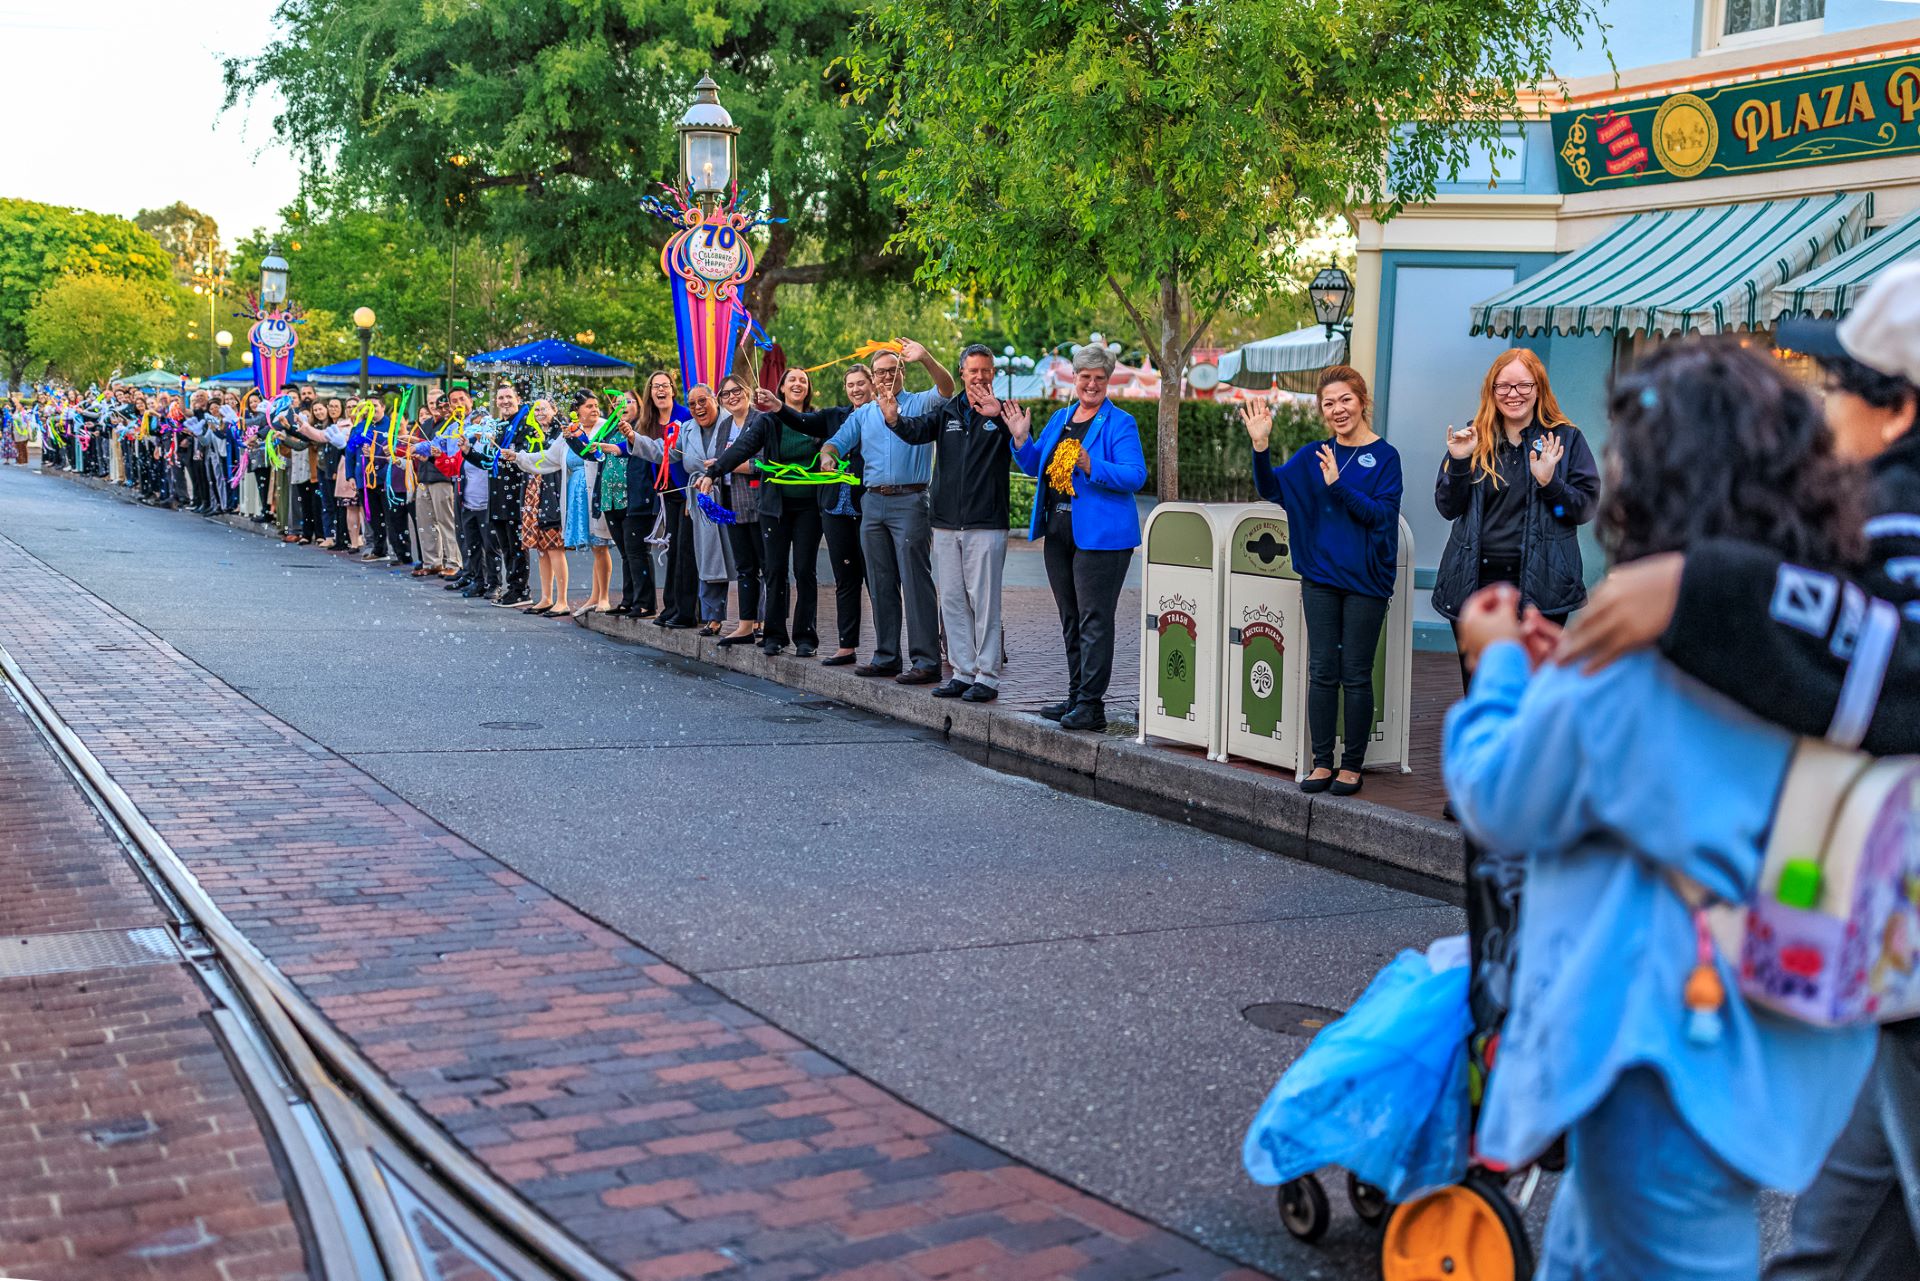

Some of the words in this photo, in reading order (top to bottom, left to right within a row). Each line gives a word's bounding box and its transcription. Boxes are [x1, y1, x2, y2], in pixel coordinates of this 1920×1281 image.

[1733, 81, 1876, 154] PLAZA
[702, 223, 736, 250] 70
[704, 259, 726, 269] HAPPY
[267, 319, 286, 331] 70
[1248, 523, 1262, 537] MIXED
[1263, 522, 1287, 541] RECYCLING
[1166, 613, 1188, 625] TRASH
[1245, 626, 1264, 638] RECYCLE
[1264, 627, 1282, 643] PLEASE
